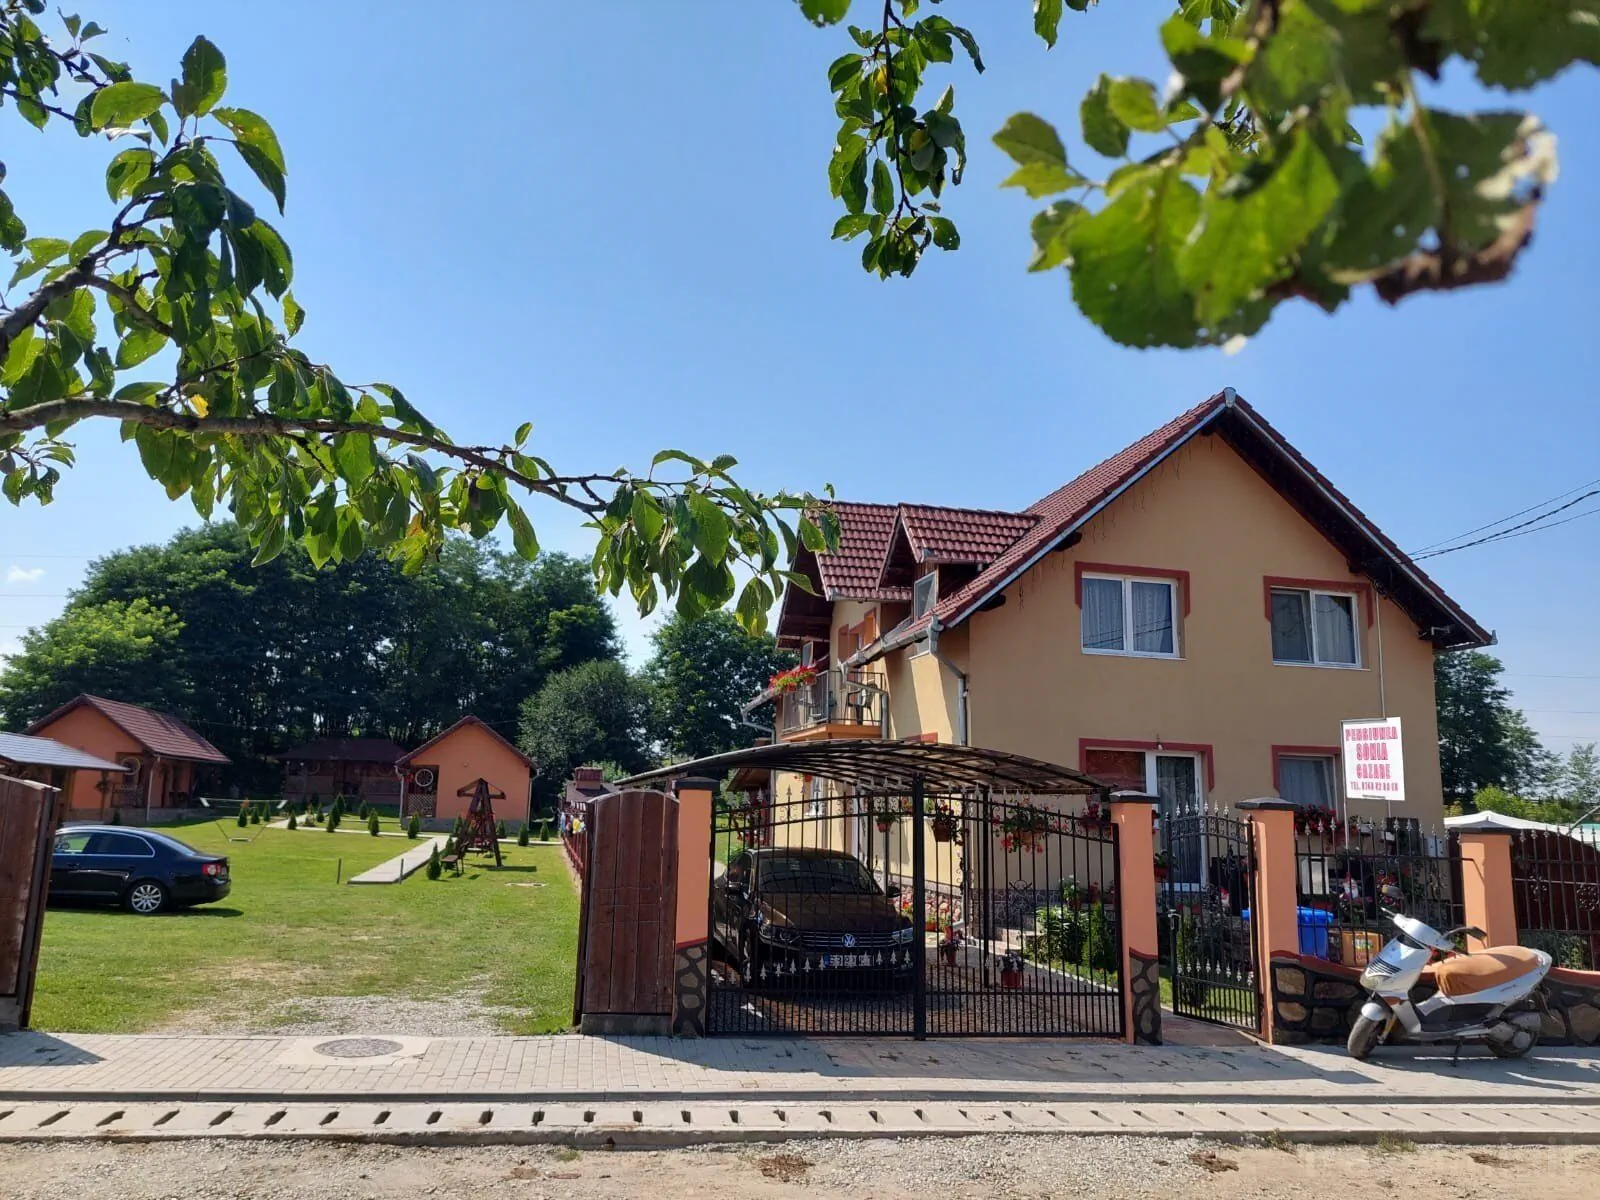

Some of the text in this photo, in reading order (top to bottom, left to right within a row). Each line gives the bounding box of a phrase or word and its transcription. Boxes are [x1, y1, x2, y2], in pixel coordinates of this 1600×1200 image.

[1345, 726, 1398, 741] PENSIUNEA
[1356, 743, 1388, 760] SONIA
[1356, 764, 1391, 779] CAZARE
